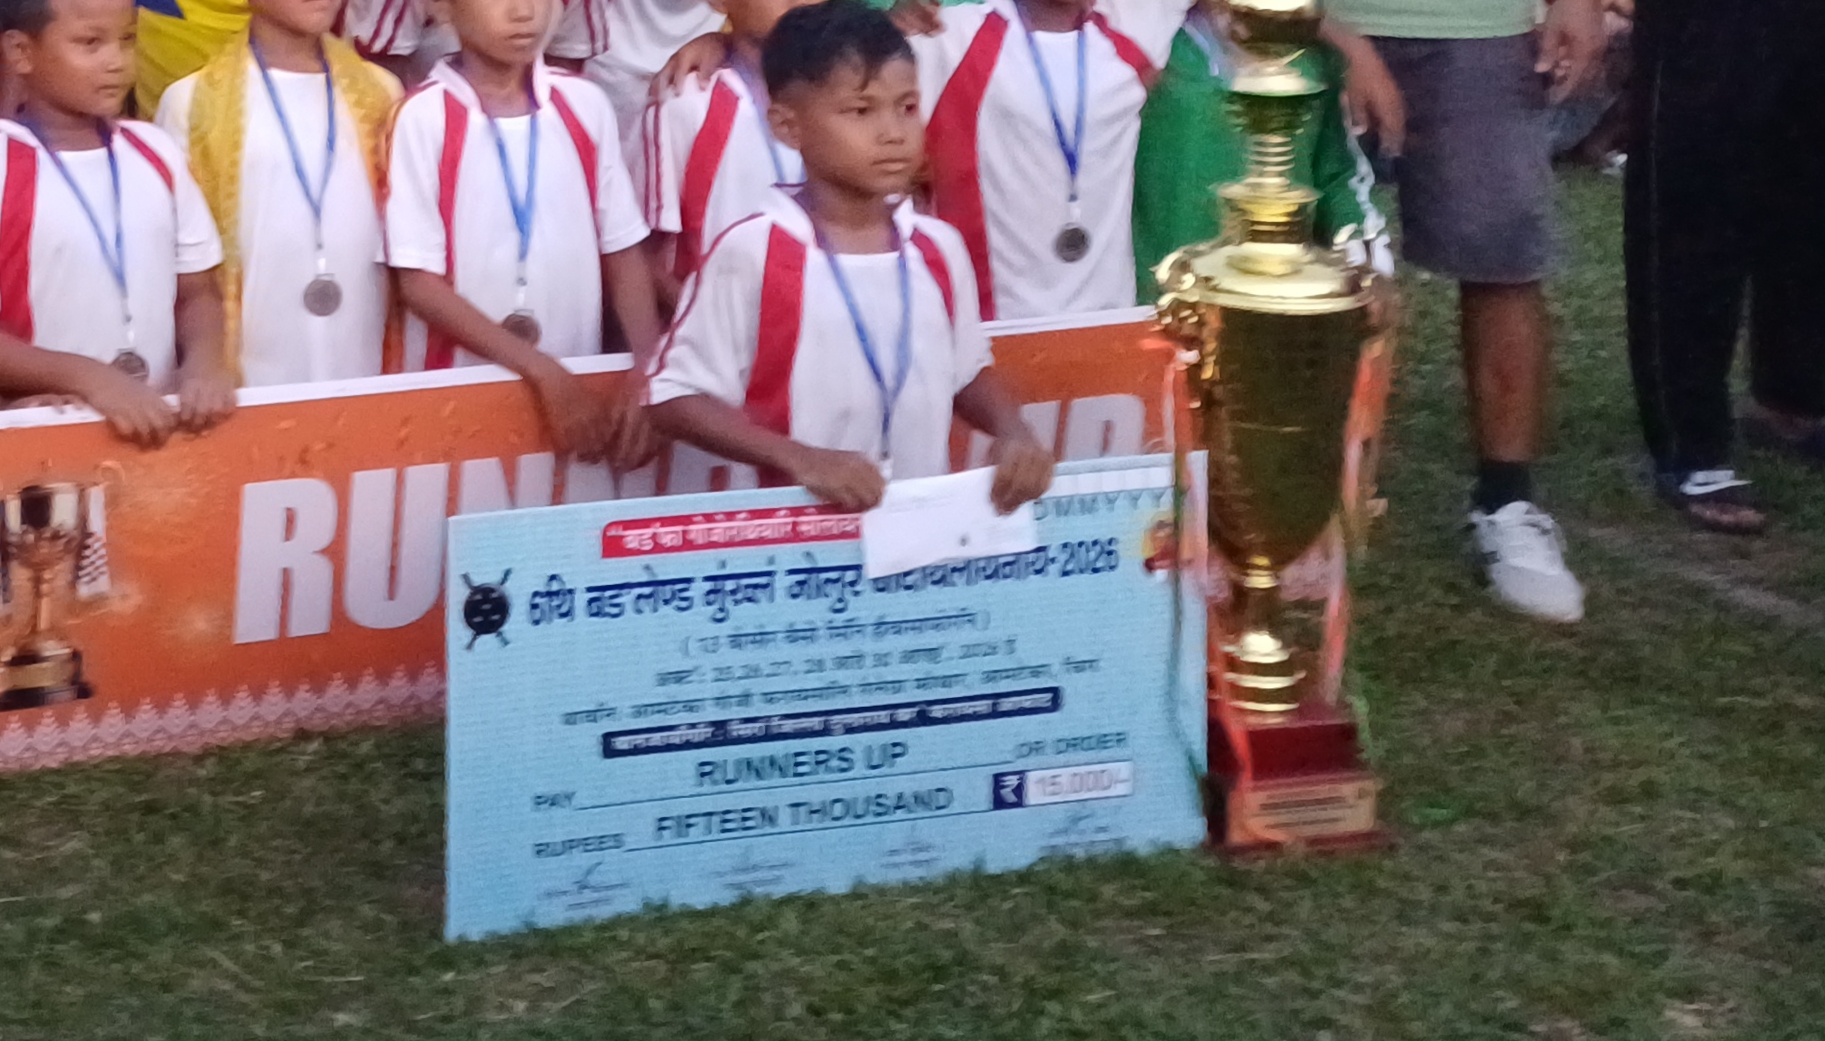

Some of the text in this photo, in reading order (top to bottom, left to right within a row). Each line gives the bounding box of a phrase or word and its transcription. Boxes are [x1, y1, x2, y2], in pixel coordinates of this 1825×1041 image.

[532, 790, 576, 809] PAY
[695, 746, 856, 787] RUNNERS
[863, 741, 909, 770] UP
[533, 833, 625, 858] RUPEES
[654, 806, 779, 842] FIFTEEN
[786, 786, 954, 826] THOUSAND
